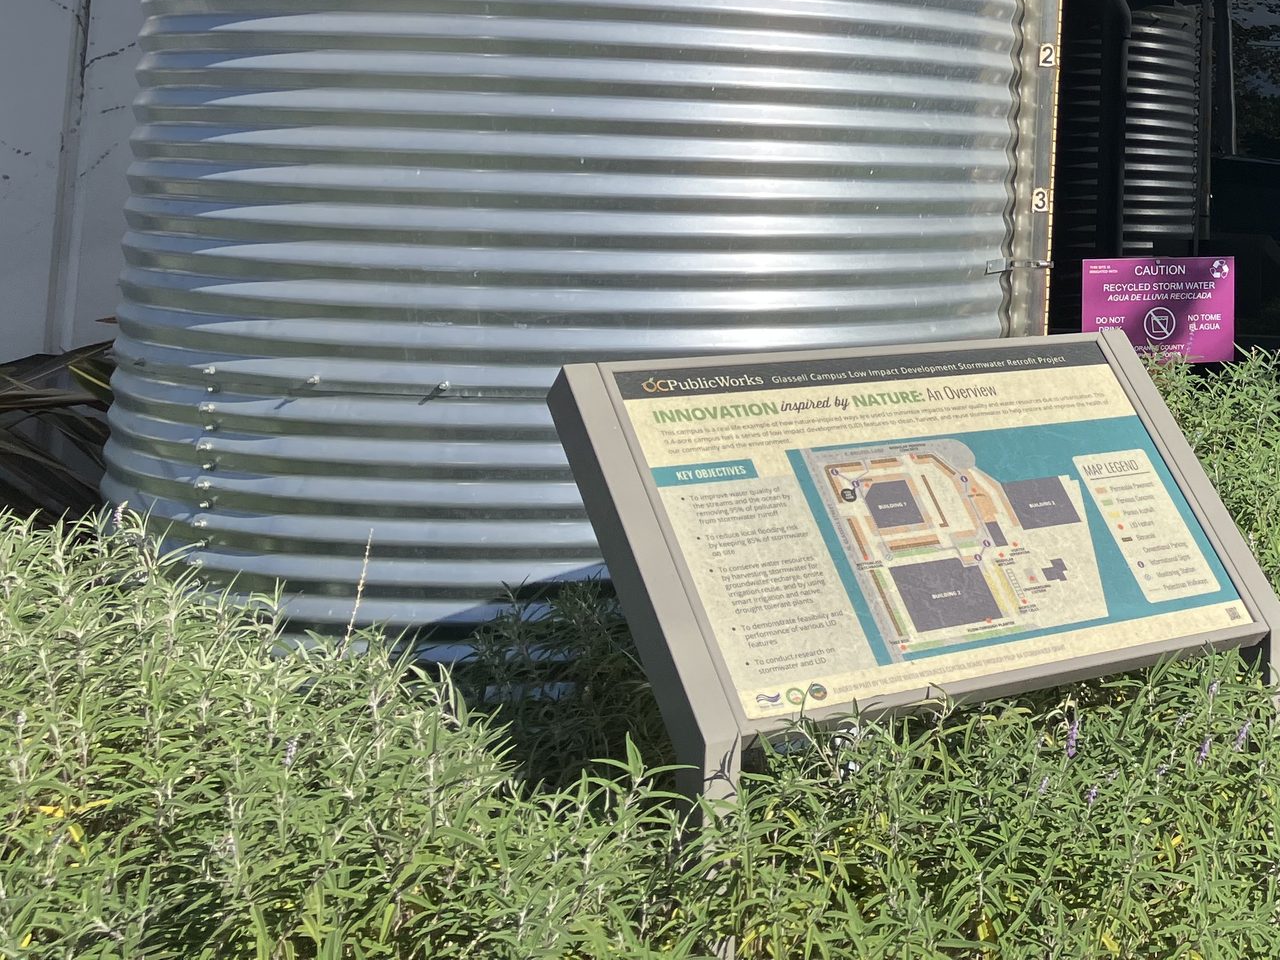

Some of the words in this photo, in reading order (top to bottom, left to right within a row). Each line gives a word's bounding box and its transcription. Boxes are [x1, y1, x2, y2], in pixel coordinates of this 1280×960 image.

[1042, 46, 1053, 64] 2
[1035, 191, 1046, 209] 3
[1134, 265, 1186, 275] CAUTION
[1103, 283, 1150, 292] RECYCLED
[1152, 282, 1184, 290] STORM
[1185, 282, 1215, 290] WATER
[1170, 292, 1212, 300] RECICLADA
[771, 371, 808, 384] Glassell
[810, 369, 847, 382] Campus
[848, 369, 867, 378] Low
[869, 366, 899, 378] Impact
[900, 363, 957, 376] Development
[958, 359, 1005, 371] Stormwater
[1007, 357, 1037, 367] Retrofit
[1037, 355, 1066, 366] Project
[652, 401, 780, 424] INNOVATION
[780, 397, 831, 414] inspired
[834, 395, 850, 410] by
[851, 390, 926, 407] NATURE:
[927, 388, 944, 402] An
[944, 384, 997, 401] Overview
[676, 470, 694, 480] KEY
[695, 465, 747, 479] OBJECTIVES
[1083, 464, 1103, 476] MAP
[1105, 460, 1139, 474] LEGEND
